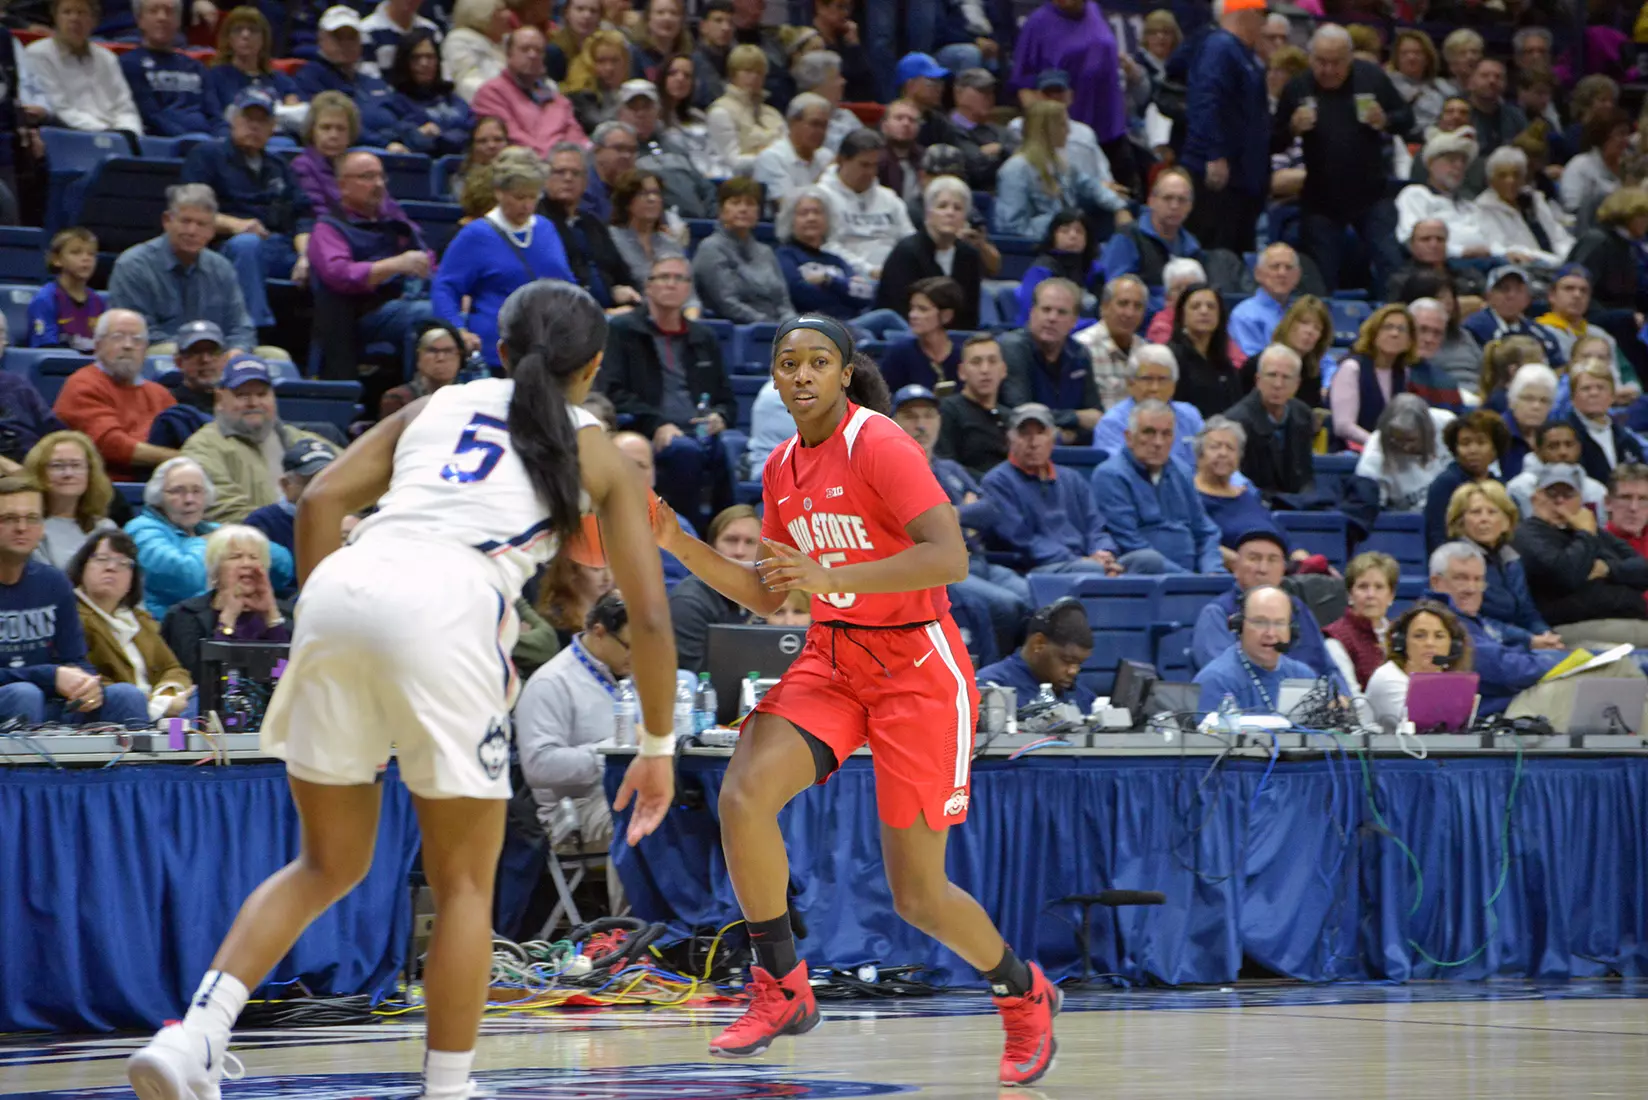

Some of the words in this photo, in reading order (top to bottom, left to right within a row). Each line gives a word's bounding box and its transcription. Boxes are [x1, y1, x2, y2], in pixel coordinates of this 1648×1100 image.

[440, 412, 509, 482] 5
[811, 512, 874, 549] STATE
[0, 605, 57, 642] CONN
